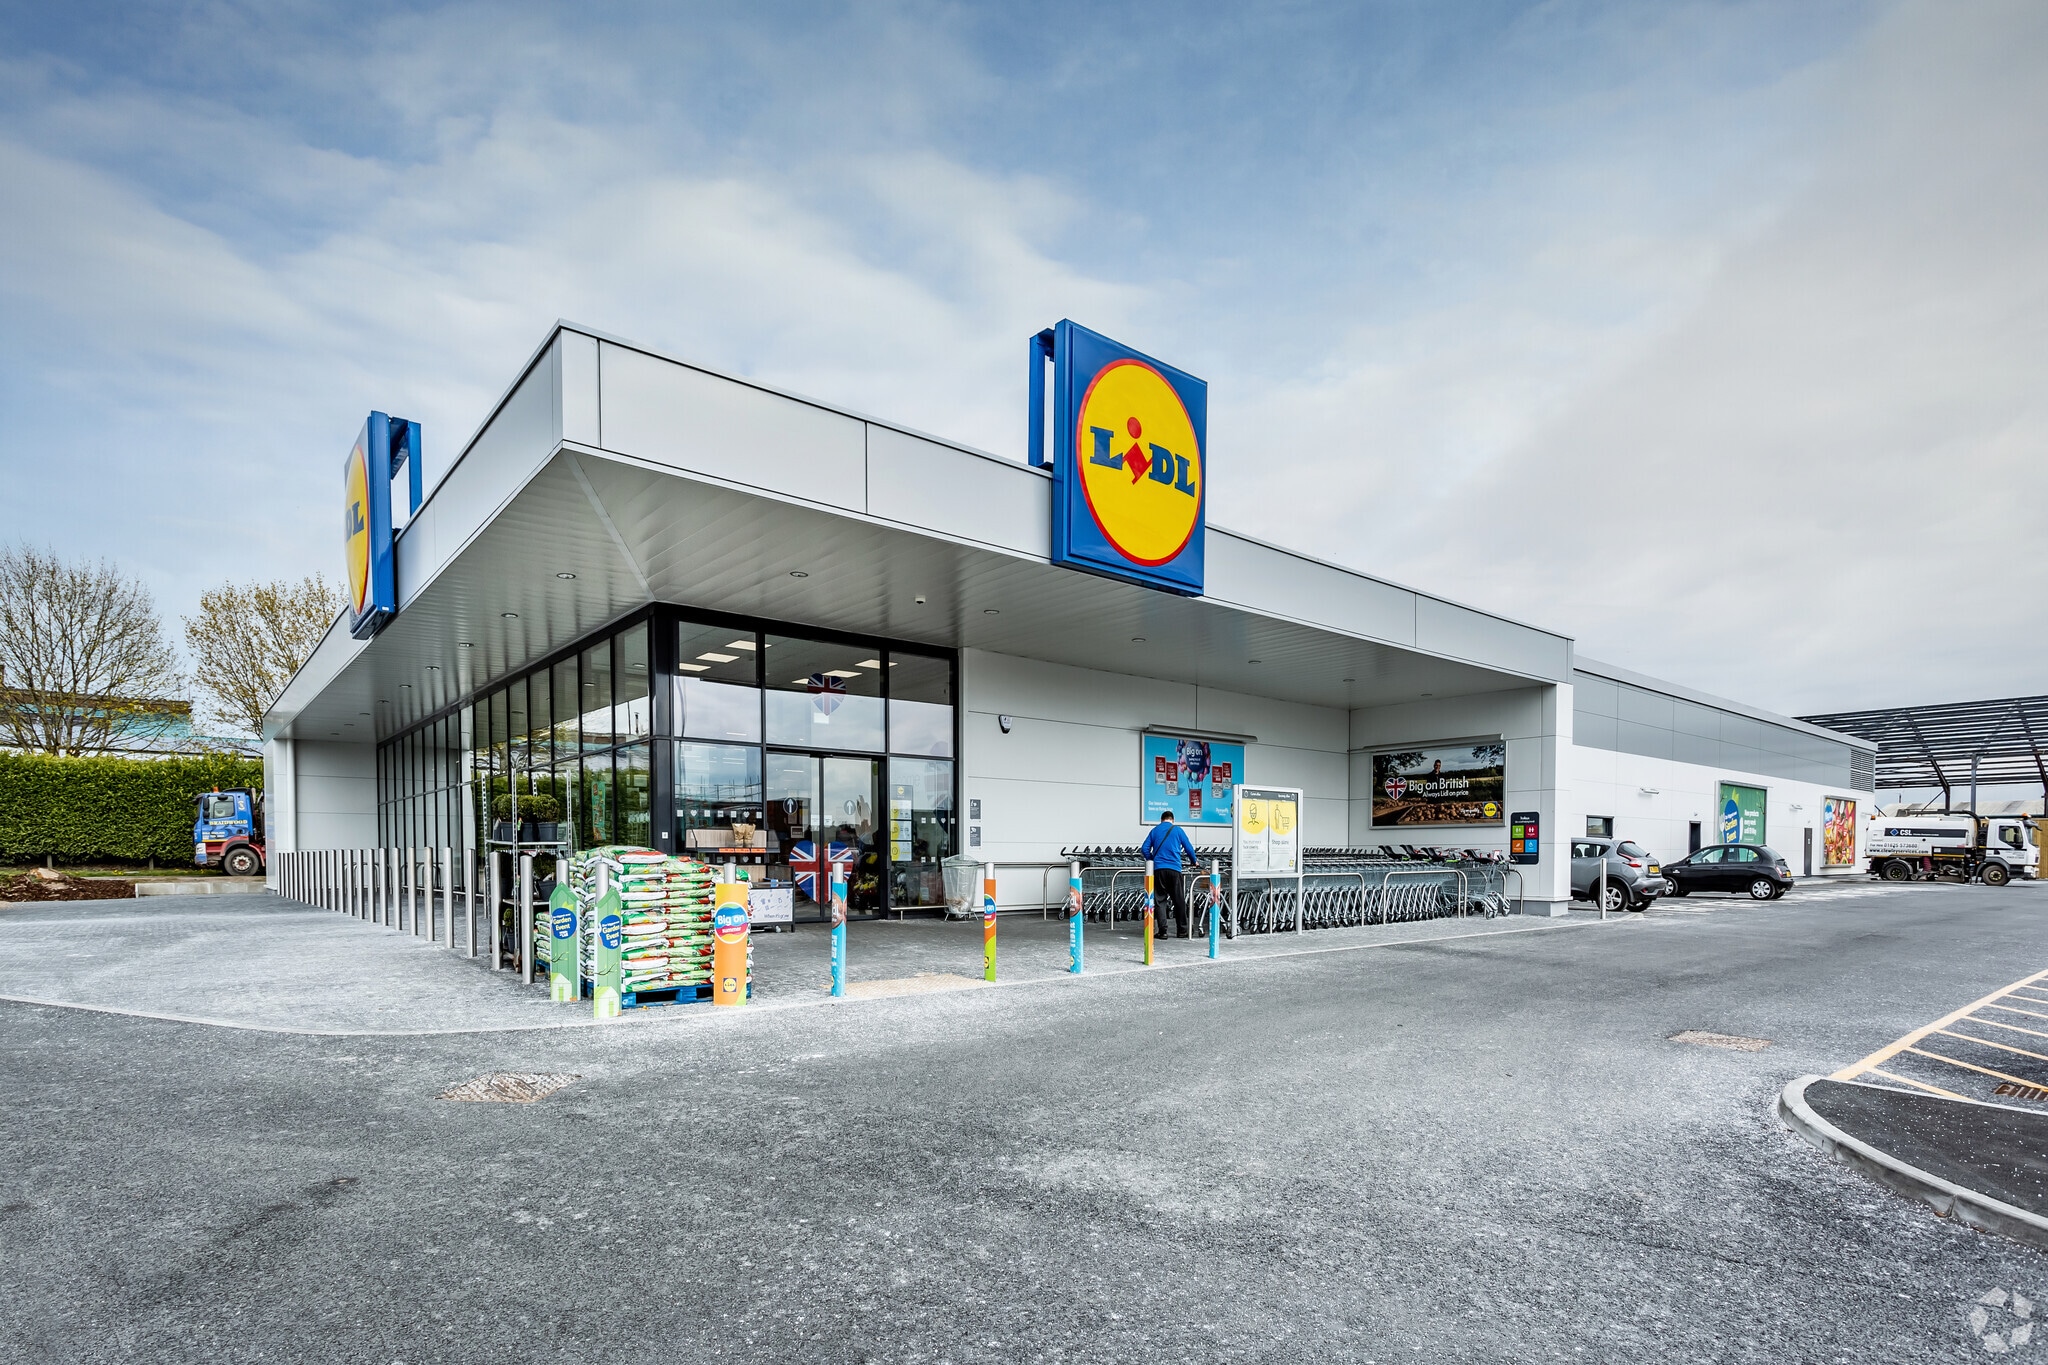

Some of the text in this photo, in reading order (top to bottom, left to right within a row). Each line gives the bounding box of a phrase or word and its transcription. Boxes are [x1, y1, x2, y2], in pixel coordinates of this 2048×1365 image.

[346, 501, 364, 543] DL
[1187, 747, 1195, 757] Big
[1409, 776, 1469, 794] Big on British
[1725, 819, 1737, 831] Garden
[1727, 831, 1736, 843] Event
[553, 917, 571, 925] Garden
[718, 915, 731, 926] Big
[555, 923, 570, 931] Event
[606, 932, 619, 940] Event
